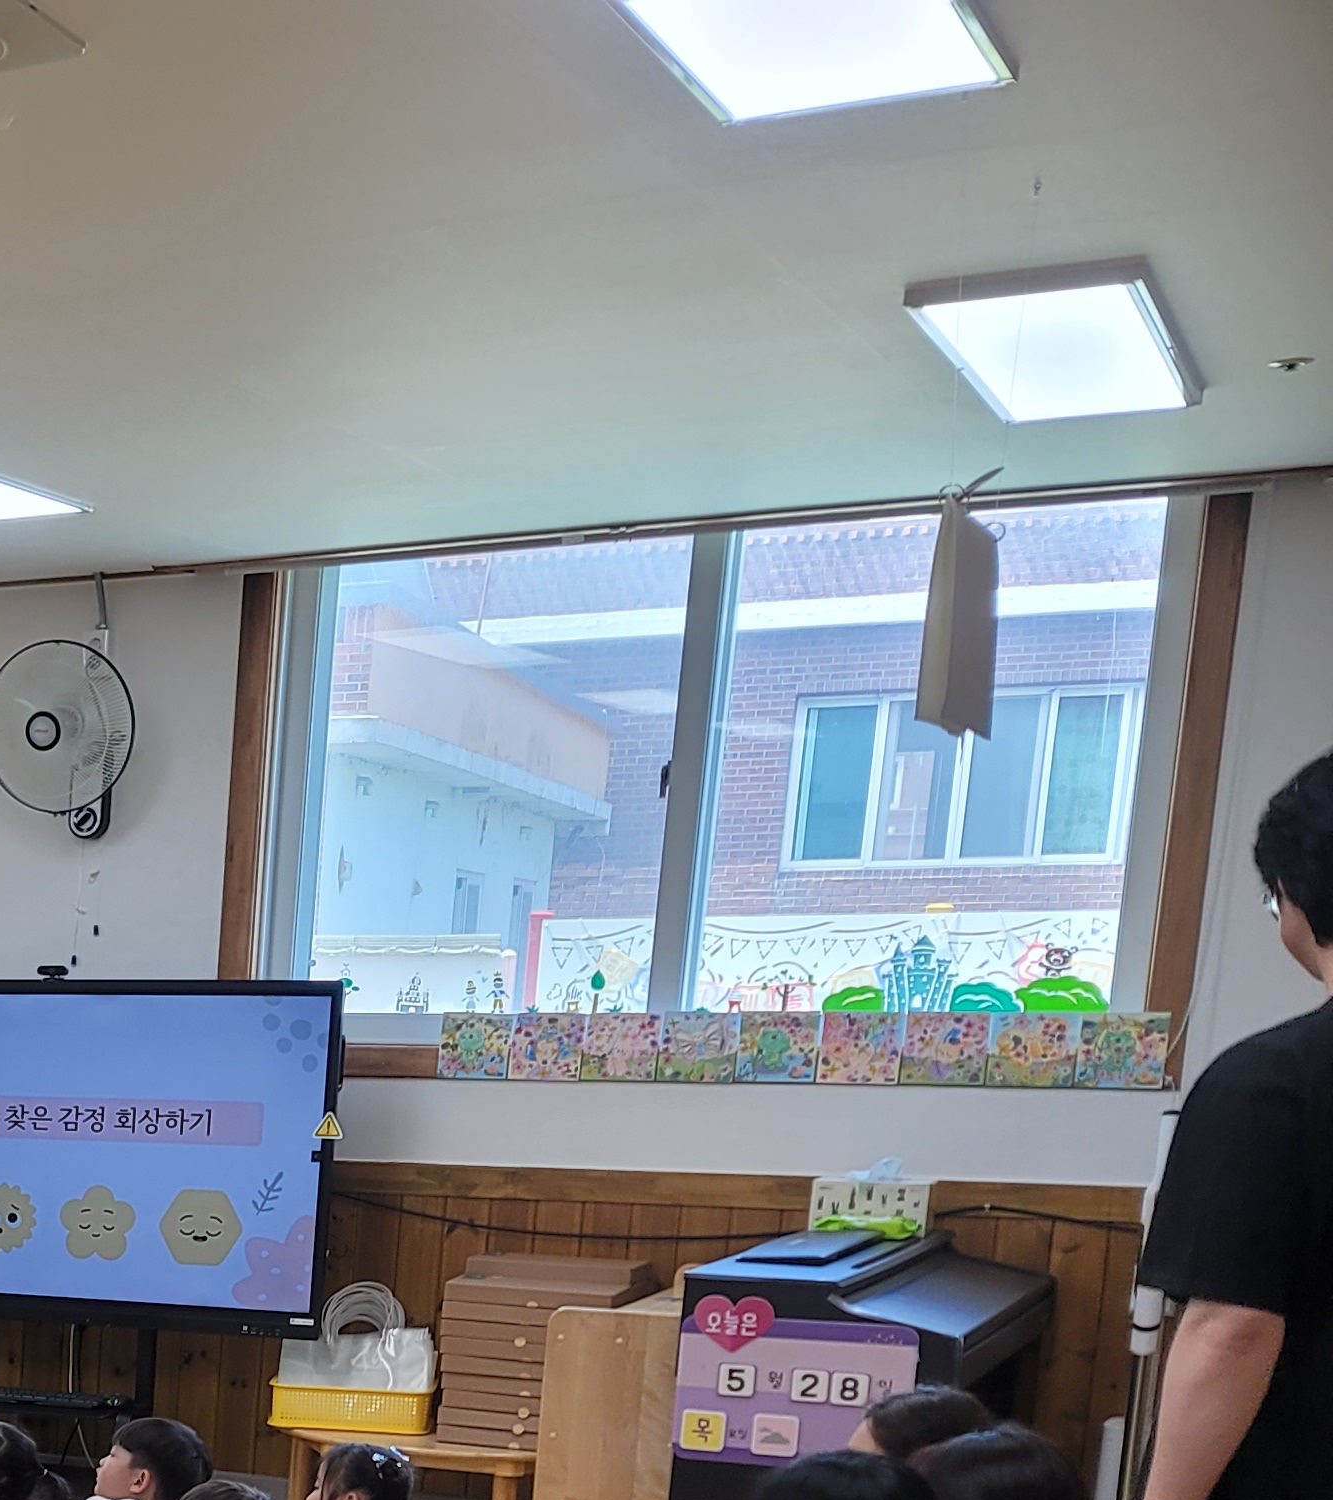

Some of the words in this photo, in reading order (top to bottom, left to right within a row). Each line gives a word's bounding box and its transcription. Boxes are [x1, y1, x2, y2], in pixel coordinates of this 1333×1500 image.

[3, 1104, 54, 1132] 찾은
[57, 1105, 107, 1135] 감정
[112, 1106, 213, 1137] 회상하기
[704, 1309, 758, 1337] 오늘은
[726, 1368, 745, 1392] 5
[767, 1370, 783, 1390] 월
[800, 1373, 860, 1401] 28
[692, 1417, 713, 1443] 목
